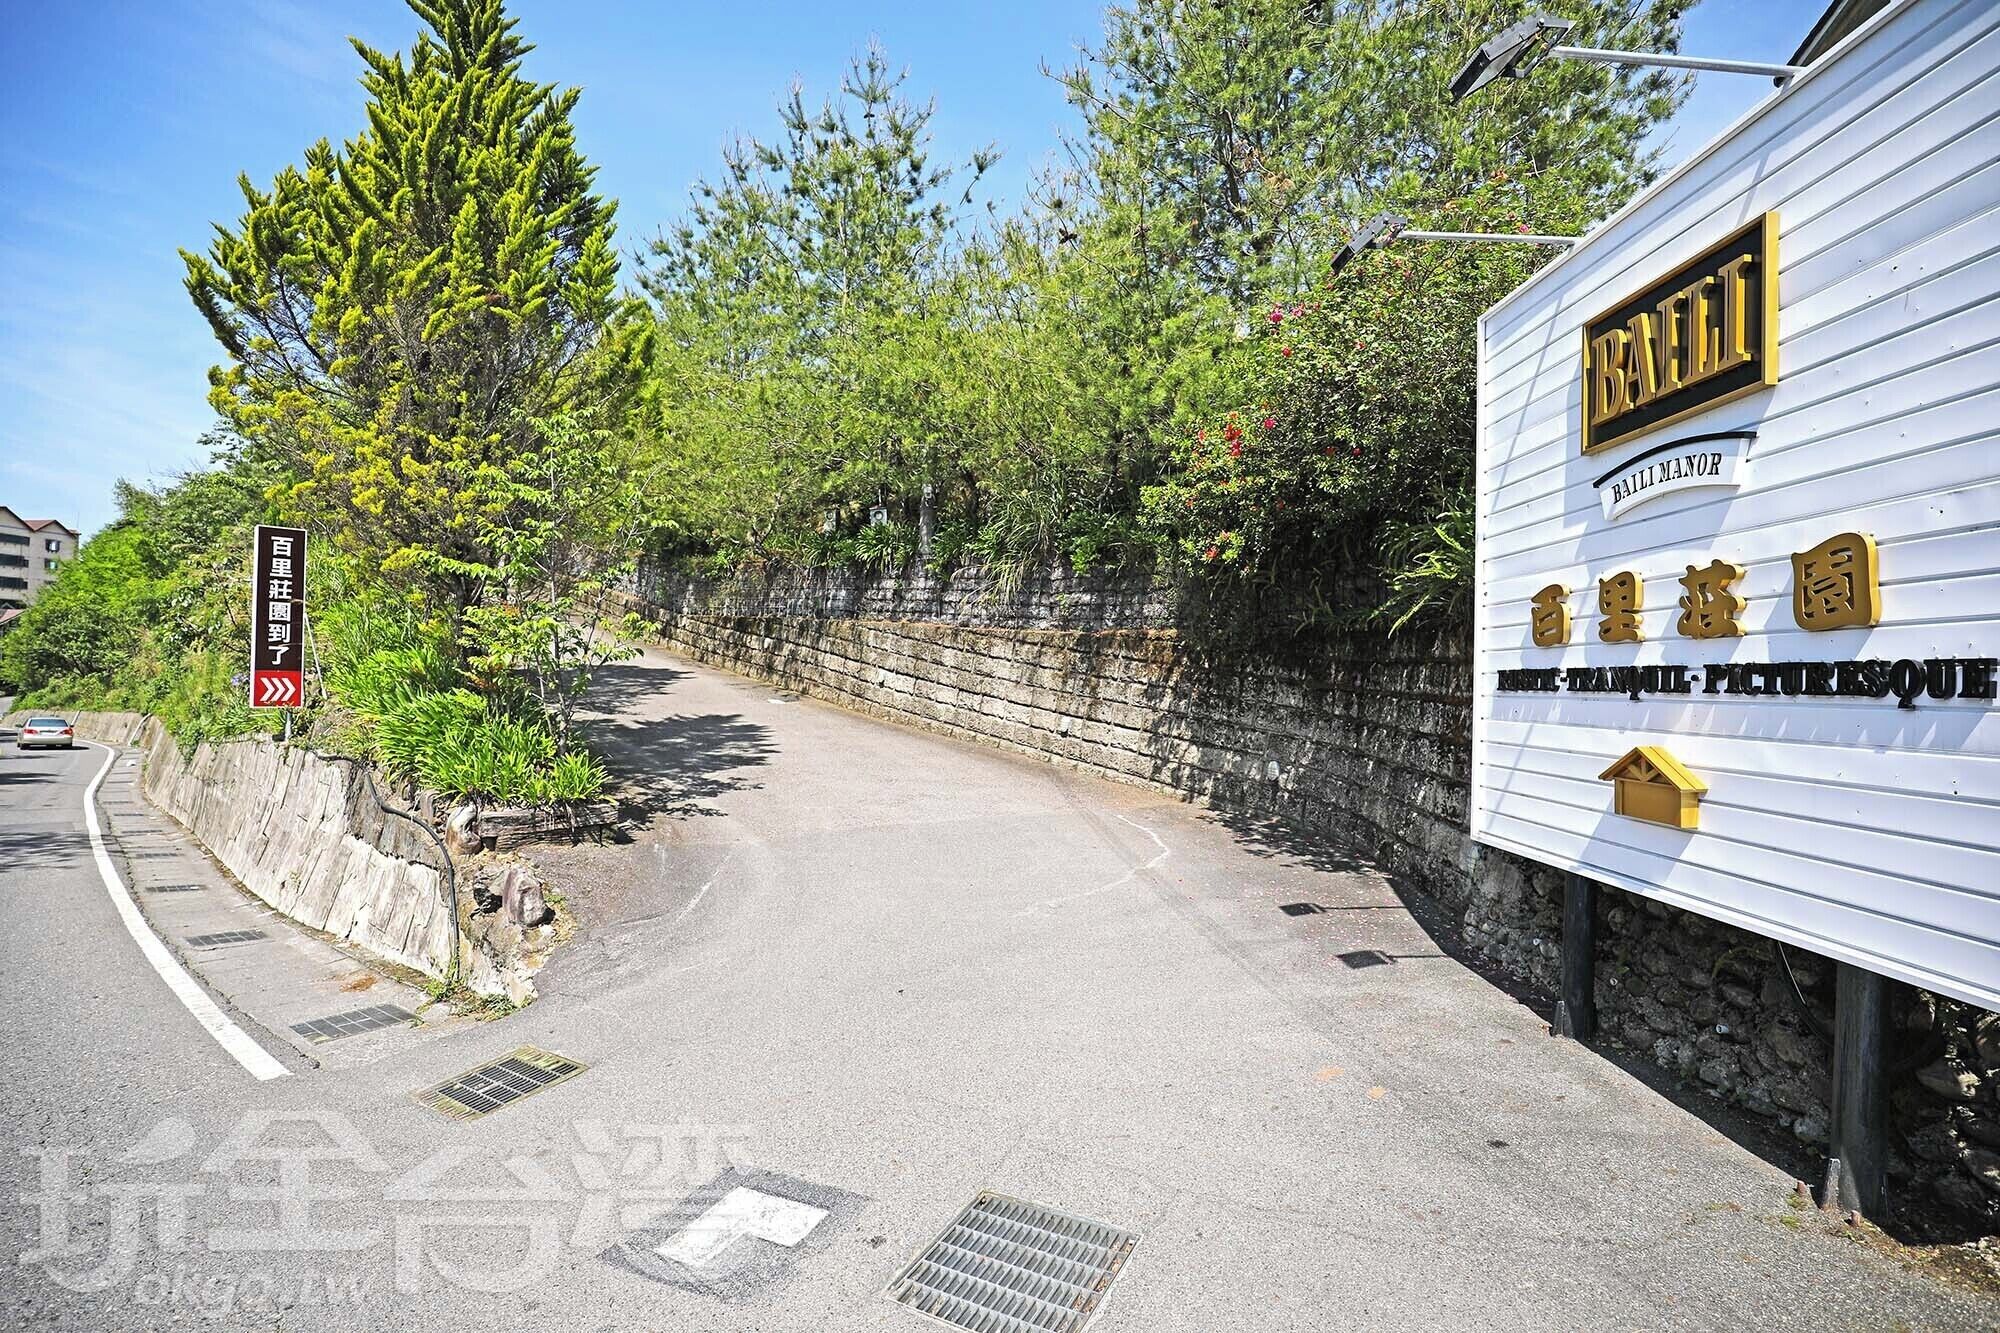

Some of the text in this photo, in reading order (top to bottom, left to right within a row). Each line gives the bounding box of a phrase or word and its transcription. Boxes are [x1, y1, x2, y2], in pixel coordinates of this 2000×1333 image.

[1591, 253, 1752, 427] BAILI
[1612, 452, 1722, 504] BAILI MANOR
[268, 535, 294, 665] 百里莊園到了
[1531, 532, 1881, 647] 百里莊園
